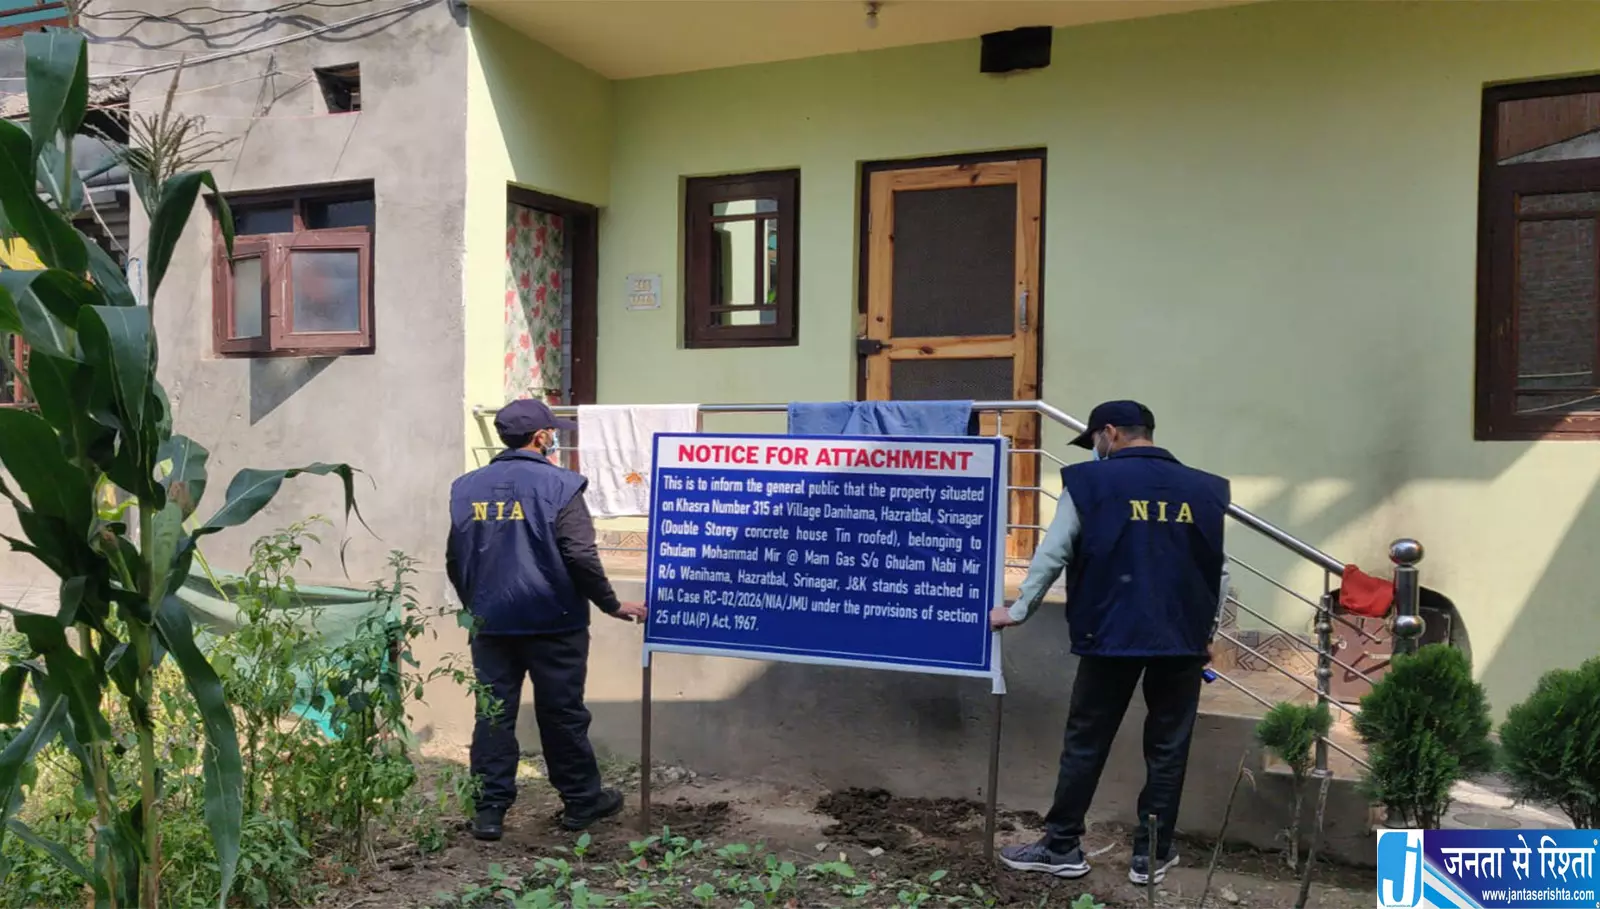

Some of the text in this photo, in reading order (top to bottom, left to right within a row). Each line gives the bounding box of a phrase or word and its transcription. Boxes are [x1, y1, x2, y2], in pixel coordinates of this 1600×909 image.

[678, 444, 973, 470] NOTICE FOR ATTACHMENT
[664, 475, 984, 503] This is to inform the general public that the property situated
[472, 501, 524, 520] NIA
[662, 498, 983, 529] on Khasra Number 315 at Village Danihama, Hazratbal, Srinagar
[1129, 500, 1194, 523] NIA
[661, 519, 981, 552] (Double Storey concrete house Tin roofed), belonging to
[660, 542, 981, 574] Ghulam Mohammad Mir @ Mam Gas S/o Ghulam Nabi Mir
[659, 564, 675, 579] R/o
[680, 566, 732, 583] Wanihama,
[738, 569, 788, 587] Hazratbal,
[845, 576, 867, 591] J&K
[872, 579, 908, 594] stands
[914, 582, 963, 597] attached
[969, 584, 979, 599] in
[658, 587, 978, 623] NIA Case RC-02/2026/NIA/JMU under the provisions of section
[656, 610, 759, 631] 25 of UA(P) Act, 1967.
